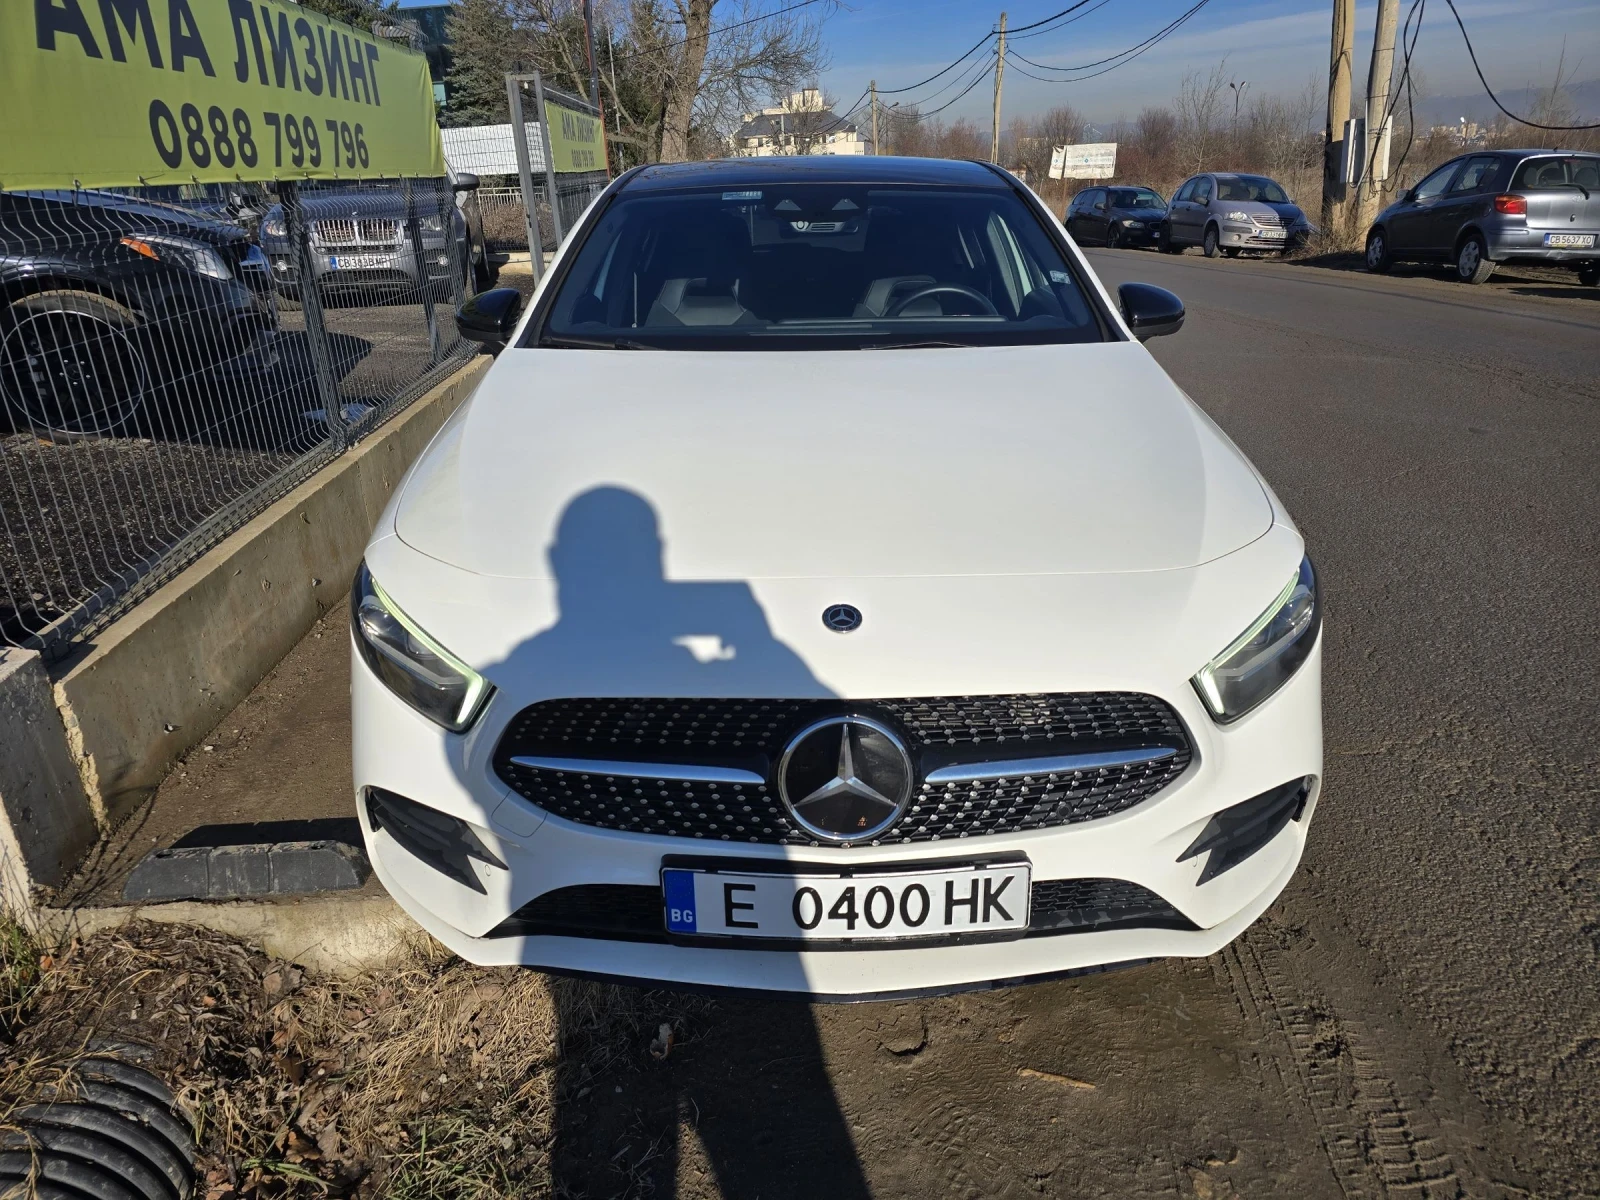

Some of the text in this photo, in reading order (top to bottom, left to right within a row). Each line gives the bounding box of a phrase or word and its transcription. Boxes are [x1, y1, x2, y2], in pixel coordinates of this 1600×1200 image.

[228, 0, 381, 107] ЛИЗИНГ
[149, 99, 370, 169] 0888 799 796
[1561, 235, 1581, 244] 5637
[671, 909, 693, 923] BG
[723, 875, 1015, 930] E 0400 HK
